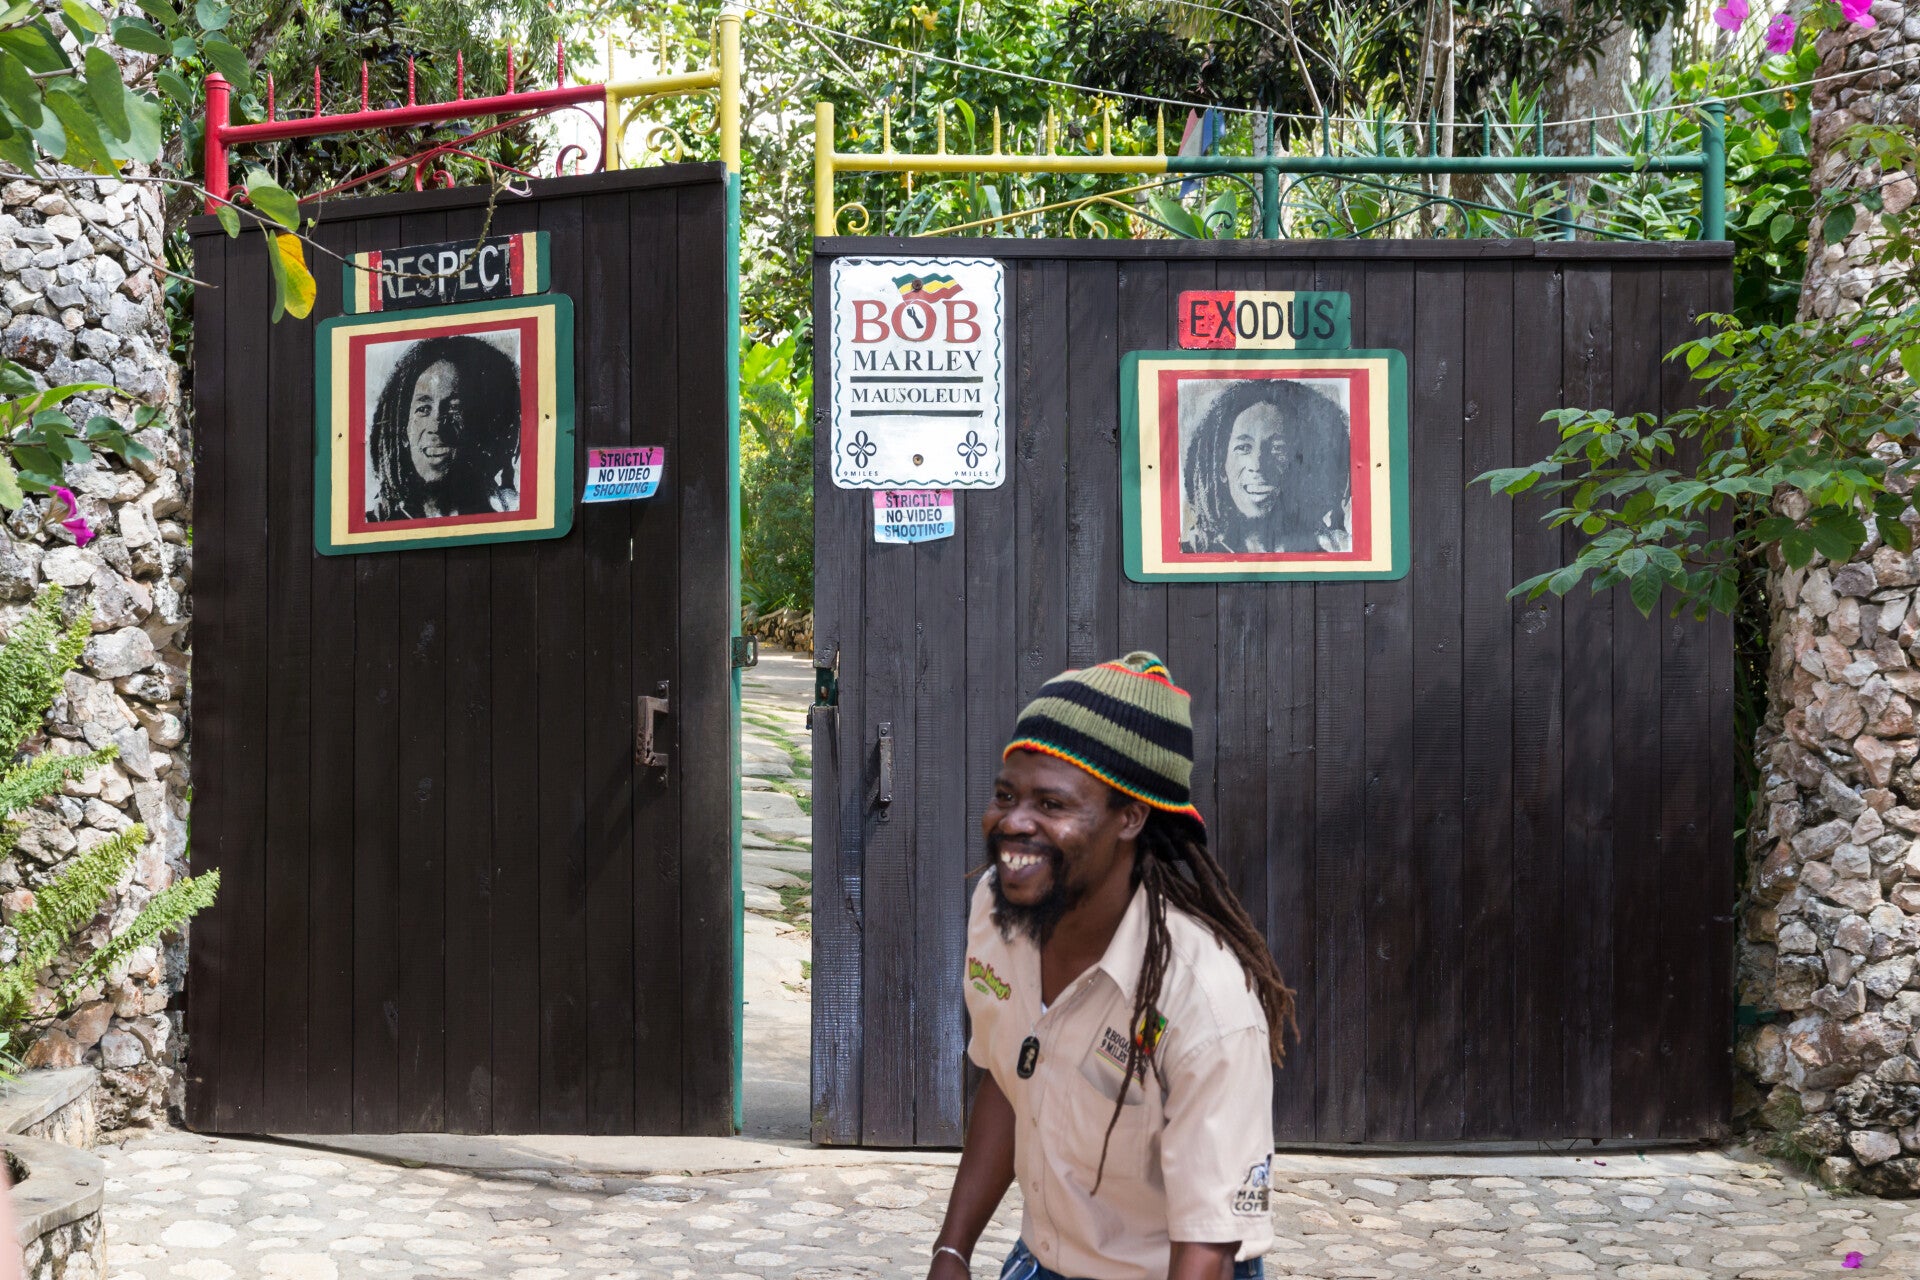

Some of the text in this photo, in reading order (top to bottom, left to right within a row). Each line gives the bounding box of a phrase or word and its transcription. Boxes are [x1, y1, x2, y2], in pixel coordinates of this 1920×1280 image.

[377, 243, 515, 301] RESPECT
[851, 299, 981, 343] BOB
[1190, 300, 1335, 340] EXODUS
[853, 350, 982, 371] MARLEY
[851, 387, 981, 403] MAUSOLEUM
[600, 452, 653, 467] STRICTLY
[598, 467, 650, 482] NO VIDEO
[593, 482, 648, 497] SHOOTING
[886, 494, 941, 508] STRICTLY
[886, 508, 942, 523] NO VIDEO
[884, 523, 945, 537] SHOOTING
